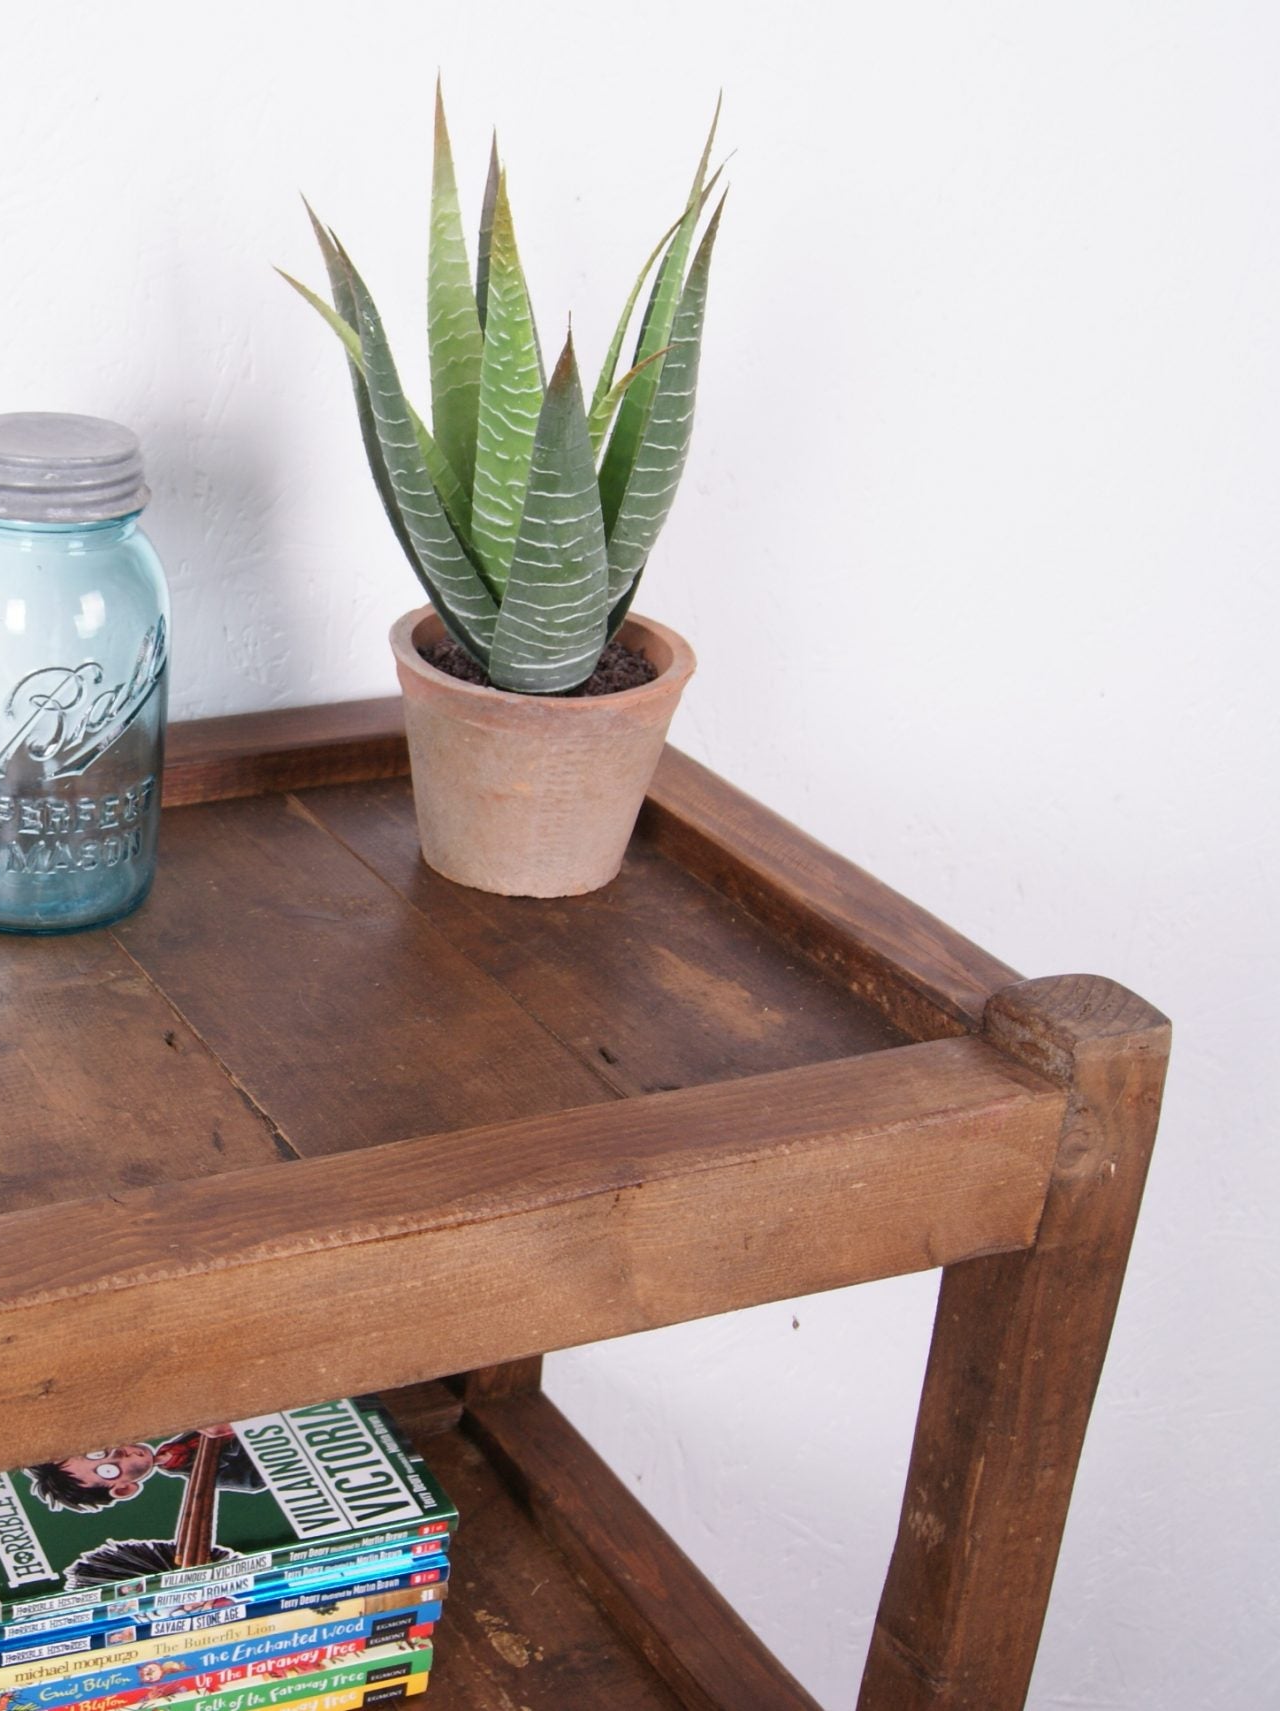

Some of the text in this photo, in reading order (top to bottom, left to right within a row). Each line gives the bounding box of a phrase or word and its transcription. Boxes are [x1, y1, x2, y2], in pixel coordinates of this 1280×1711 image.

[6, 827, 143, 876] MASON
[289, 1399, 412, 1522] VICTORIA
[244, 1424, 341, 1533] VILLAINOUS
[418, 1492, 438, 1510] Terry
[163, 1556, 267, 1587] VILLAINOUS VICTORIANS
[16, 1592, 99, 1616] HORRIBLE HISTORIES
[157, 1578, 250, 1606] RUTHLESS ROMANS
[281, 1598, 299, 1609] Terry
[353, 1582, 375, 1594] Martin
[377, 1578, 400, 1590] Brown
[8, 1613, 90, 1638] HORRIBLE HISTORIES
[154, 1607, 239, 1634] SAVAGE STONE AGE
[375, 1617, 413, 1631] EGMONT
[5, 1639, 88, 1664] HORRIBLE HISTORIES
[153, 1623, 276, 1655] The Butterfly Lion
[200, 1618, 365, 1667] The Enchanted Wood
[369, 1631, 406, 1645] EGMONT
[15, 1650, 140, 1682] michael morpurgo
[217, 1667, 242, 1683] The
[246, 1647, 319, 1681] Faraway
[324, 1642, 357, 1659] Tree
[370, 1668, 408, 1681] EGMONT
[39, 1672, 133, 1701] Enid Blyton
[229, 1694, 245, 1709] of
[247, 1692, 266, 1706] the
[269, 1678, 328, 1702] Faraway
[330, 1672, 365, 1687] Tree
[367, 1689, 403, 1703] EGMONT
[79, 1694, 129, 1711] Blyton
